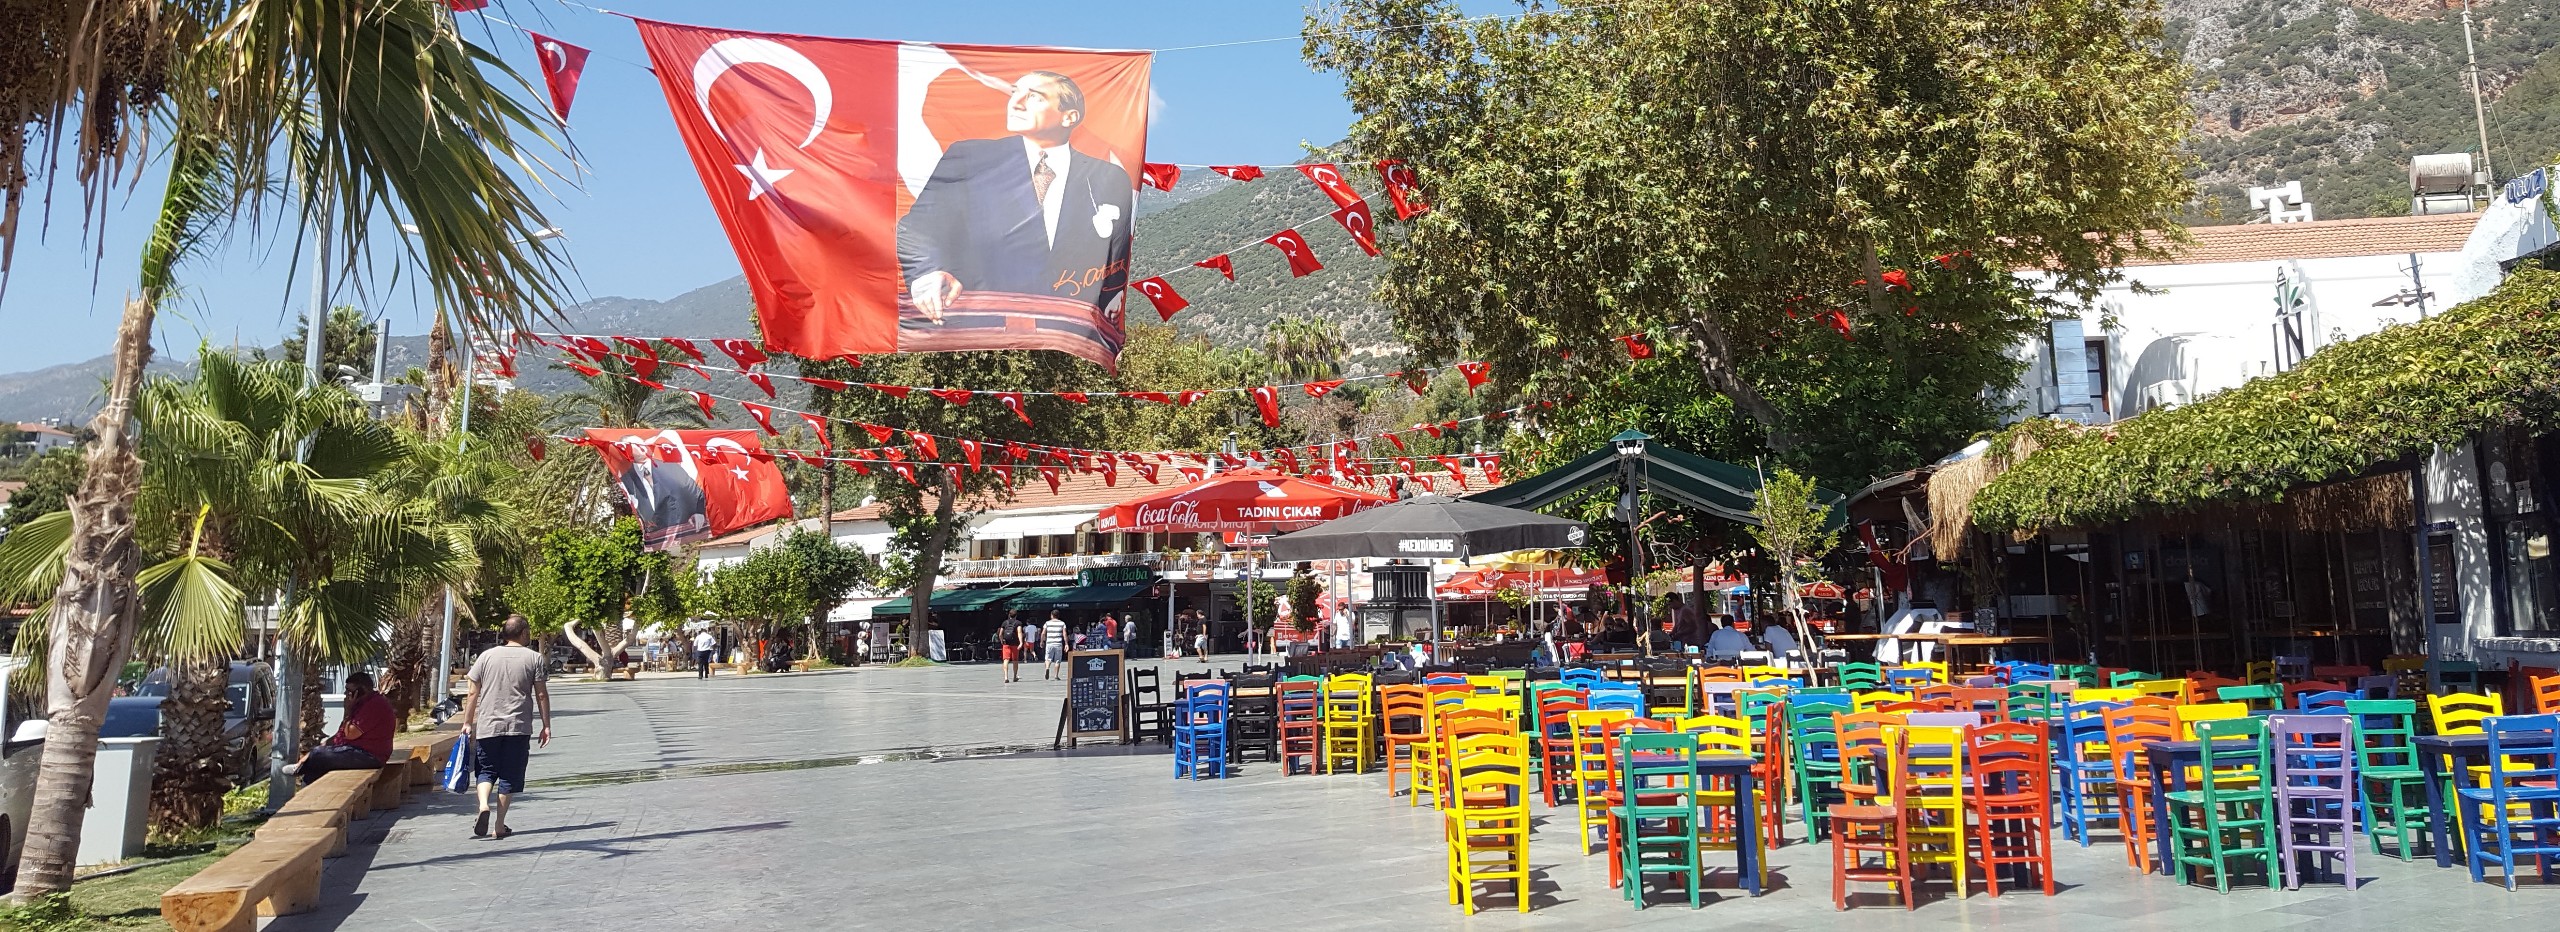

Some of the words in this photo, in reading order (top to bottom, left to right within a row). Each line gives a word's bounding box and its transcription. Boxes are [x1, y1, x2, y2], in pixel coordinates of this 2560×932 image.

[1136, 500, 1200, 527] Coca-Cola
[1237, 507, 1280, 518] TADINI
[1282, 506, 1322, 519] ÇIKAR
[1094, 568, 1119, 582] Noel
[1121, 567, 1149, 581] Baba
